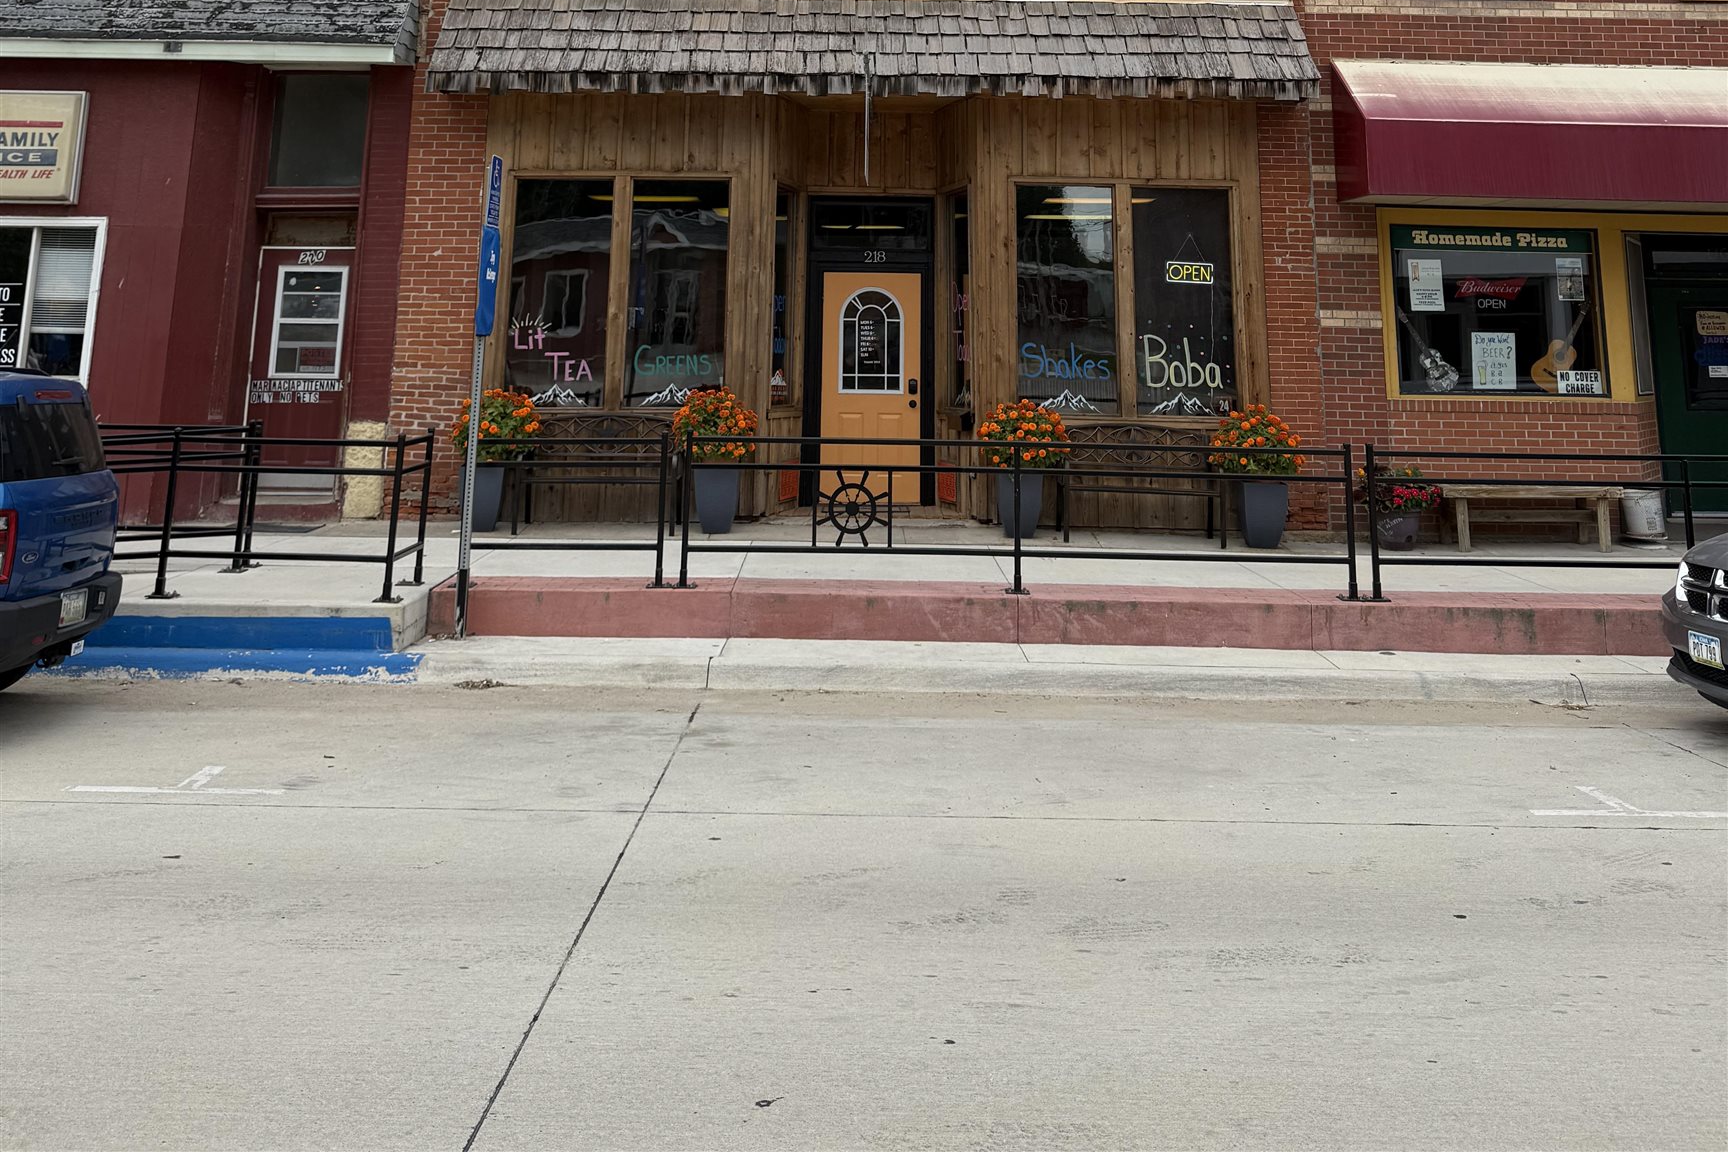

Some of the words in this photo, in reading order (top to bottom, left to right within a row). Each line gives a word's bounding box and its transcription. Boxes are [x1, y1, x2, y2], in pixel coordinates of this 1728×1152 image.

[31, 169, 55, 179] LIFE
[1411, 230, 1512, 246] Homemade
[1516, 233, 1568, 248] Pizza
[299, 249, 326, 264] 220
[864, 250, 886, 263] 218
[1168, 264, 1211, 281] OPEN
[1456, 280, 1521, 294] Budweiser
[1477, 298, 1507, 309] OPEN
[514, 327, 546, 349] Lit
[1474, 334, 1485, 345] Do
[544, 352, 593, 381] TEA
[634, 345, 711, 376] GREENS
[1020, 342, 1111, 381] Shakes
[1143, 334, 1223, 389] Boba
[1560, 372, 1570, 382] NO
[1574, 372, 1600, 382] COVER
[1565, 383, 1595, 393] CHARGE
[251, 392, 273, 403] ONLY
[280, 392, 292, 403] NO
[296, 392, 319, 403] PETS
